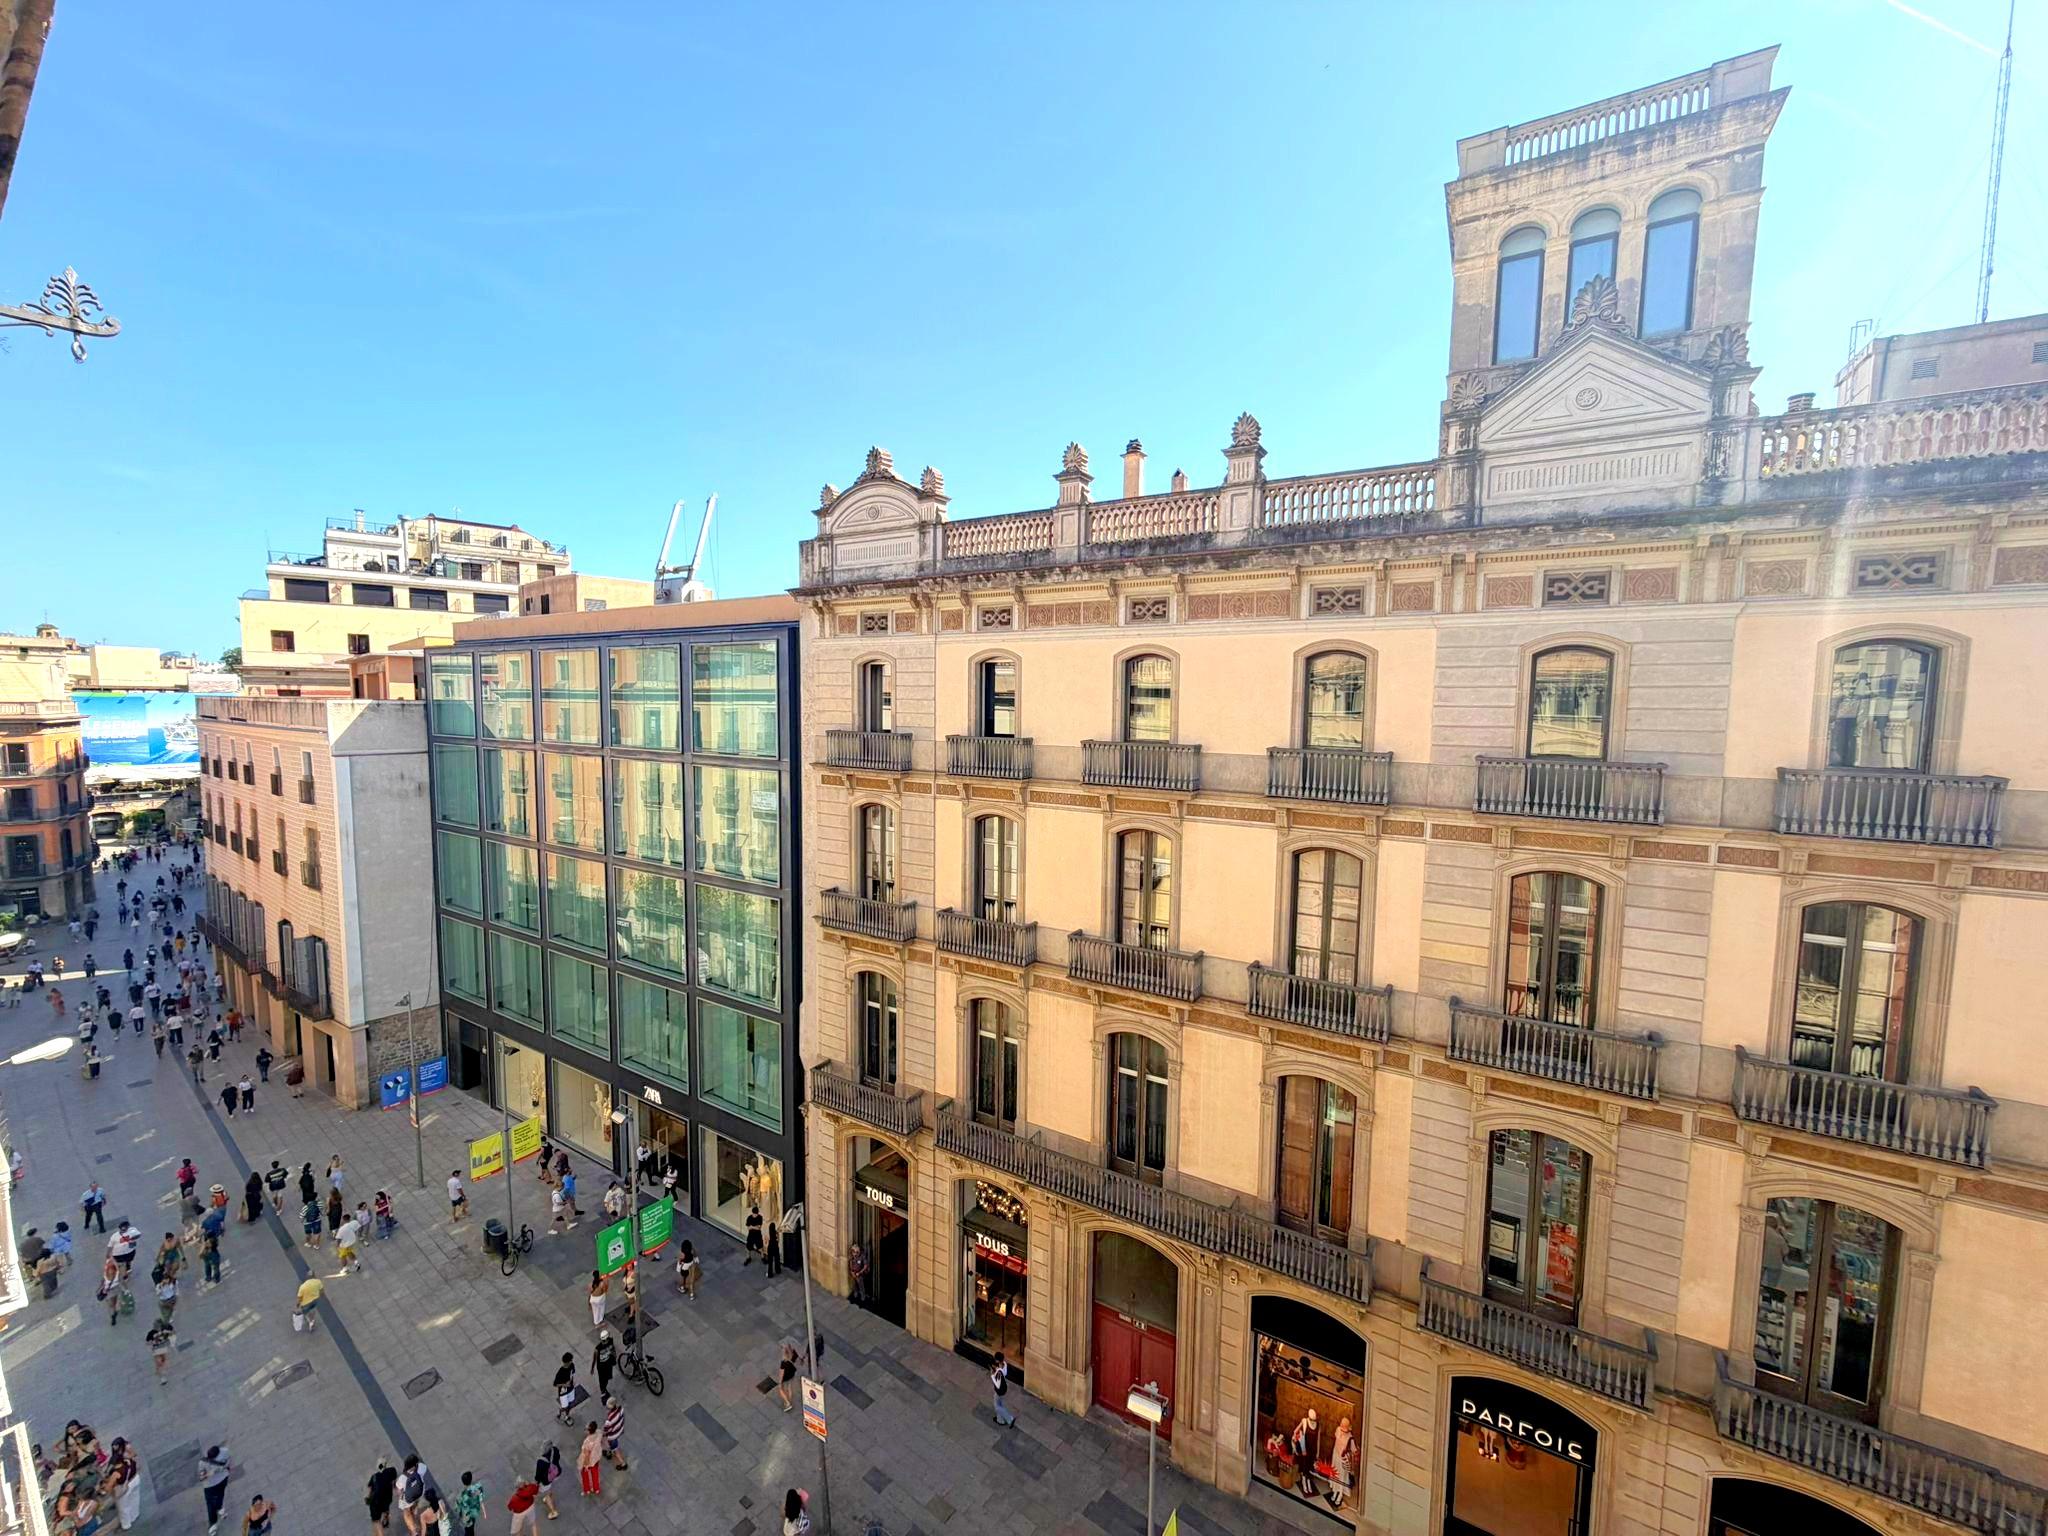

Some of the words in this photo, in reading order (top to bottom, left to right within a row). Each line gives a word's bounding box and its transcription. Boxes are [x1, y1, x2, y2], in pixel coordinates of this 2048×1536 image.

[865, 1186, 893, 1208] TOUS
[975, 1232, 1009, 1256] TOUS
[1462, 1399, 1582, 1460] PARFOIS
